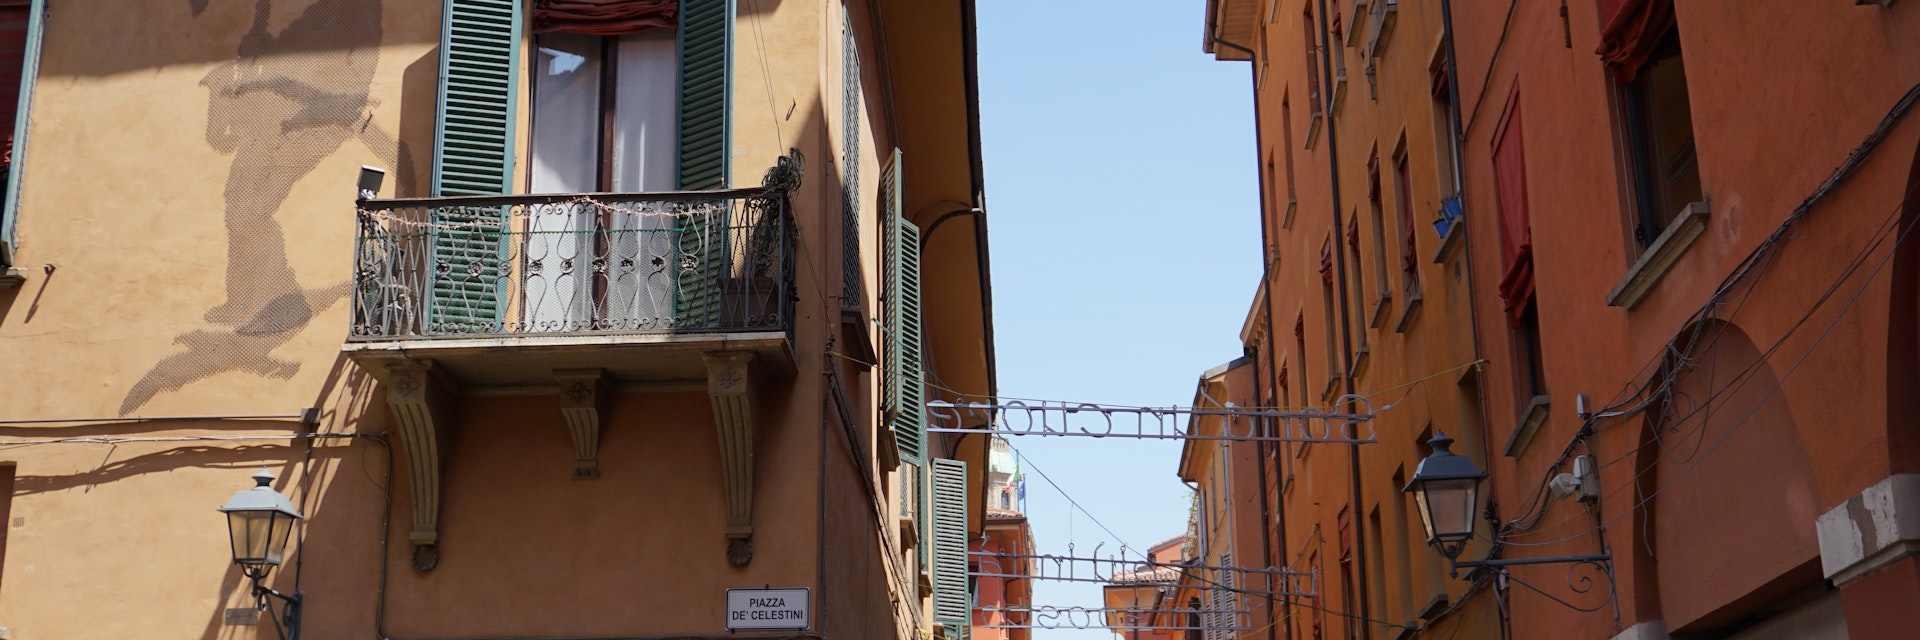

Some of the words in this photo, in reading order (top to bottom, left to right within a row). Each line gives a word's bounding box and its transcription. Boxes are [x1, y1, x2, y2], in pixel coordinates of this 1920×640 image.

[749, 598, 786, 608] PIAZZA
[732, 610, 749, 620] DE'
[751, 610, 803, 620] CELESTINI
